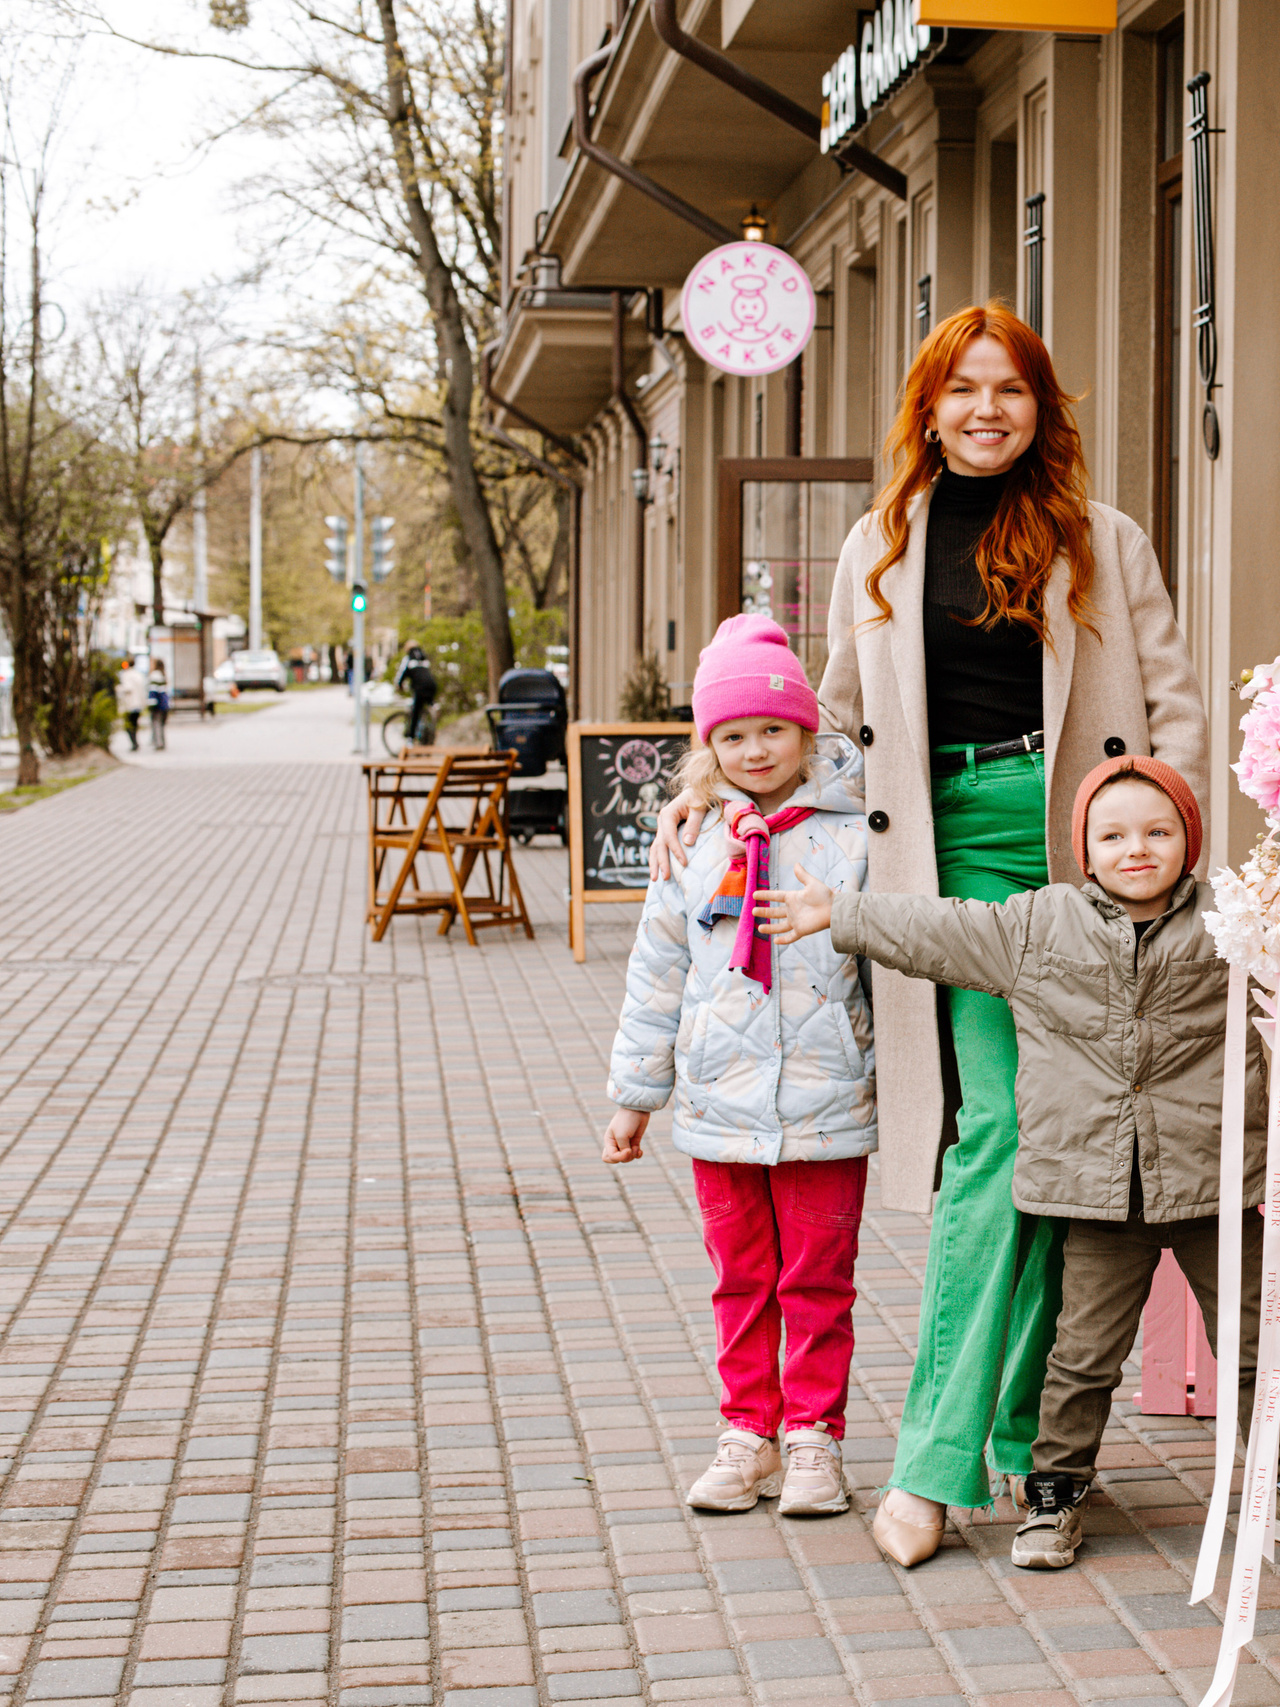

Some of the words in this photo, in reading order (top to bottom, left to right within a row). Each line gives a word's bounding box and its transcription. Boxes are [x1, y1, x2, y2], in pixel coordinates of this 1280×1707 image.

[860, 0, 931, 111] GARAG
[698, 252, 799, 294] NAKED
[700, 324, 797, 364] BAKER
[1265, 1270, 1277, 1326] TENDER
[1266, 1368, 1280, 1423] TENDER
[1251, 1465, 1267, 1523] TENDER
[1238, 1566, 1254, 1623] TENDER
